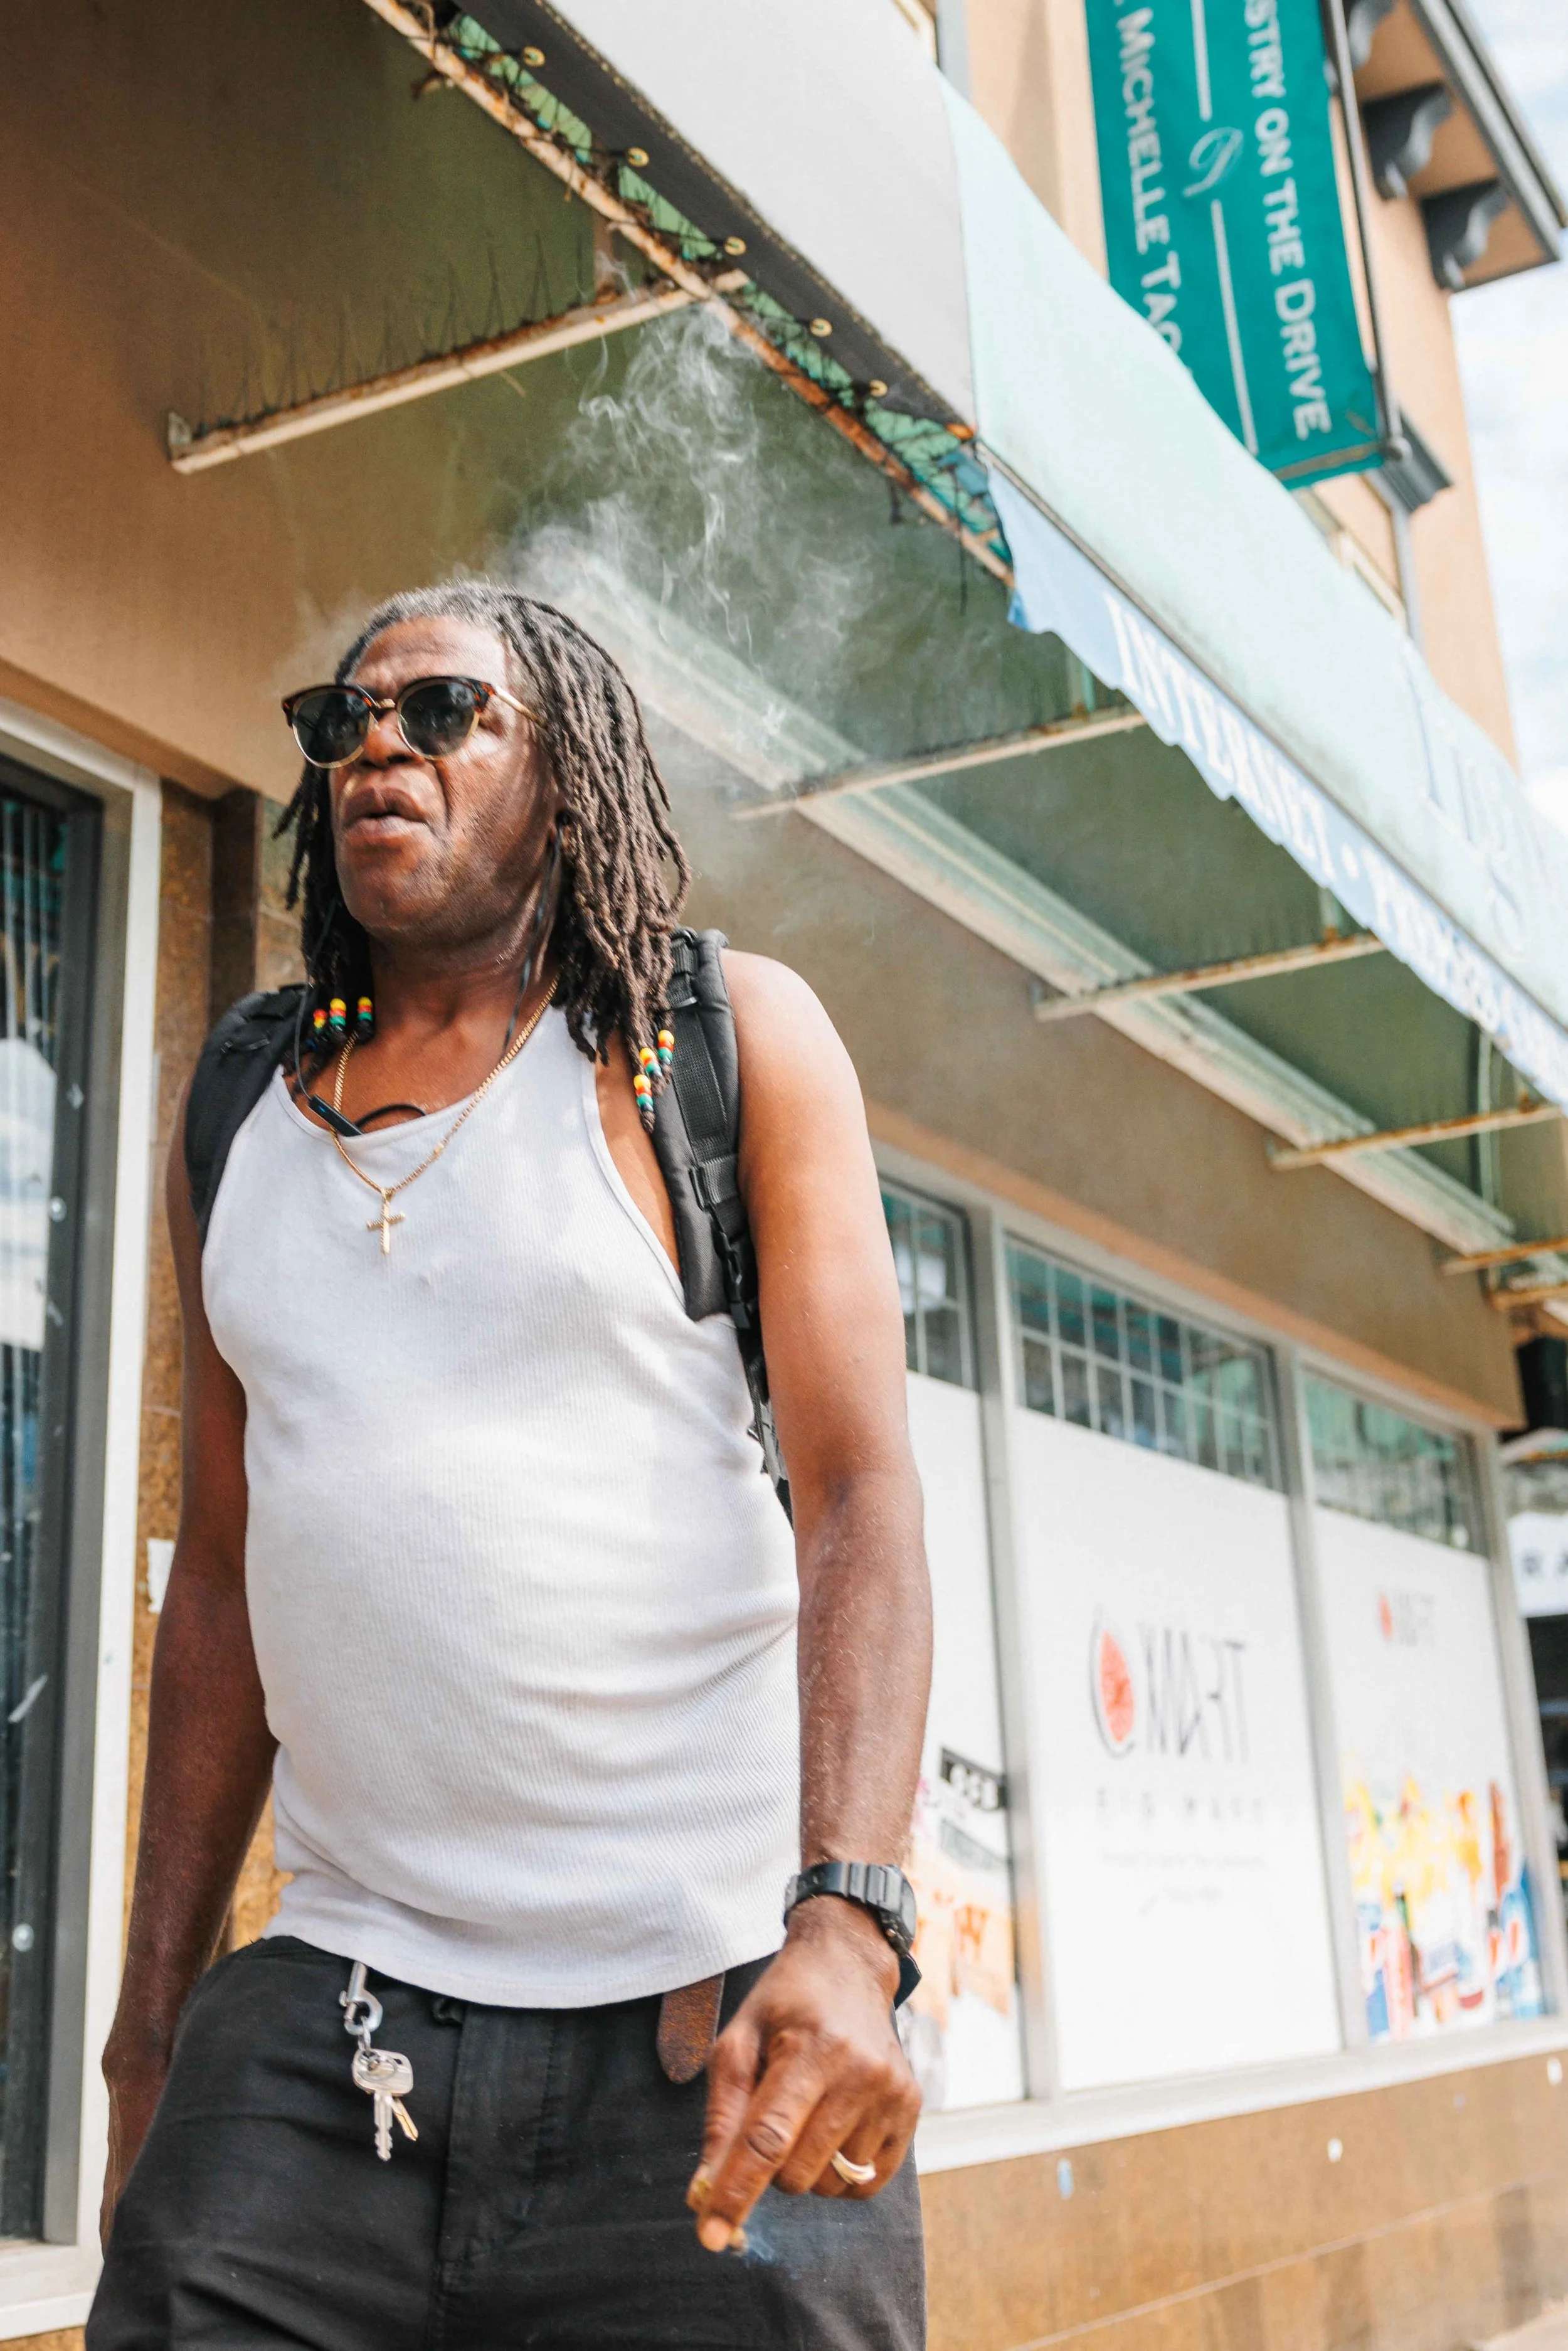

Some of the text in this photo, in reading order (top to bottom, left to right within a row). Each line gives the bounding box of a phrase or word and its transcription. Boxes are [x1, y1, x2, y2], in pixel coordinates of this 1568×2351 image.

[1116, 7, 1171, 255] MICHELLE
[1254, 107, 1293, 177] ON
[1263, 178, 1305, 275] THE
[1274, 278, 1332, 440] DRIVE
[1104, 591, 1337, 881] INTERNET
